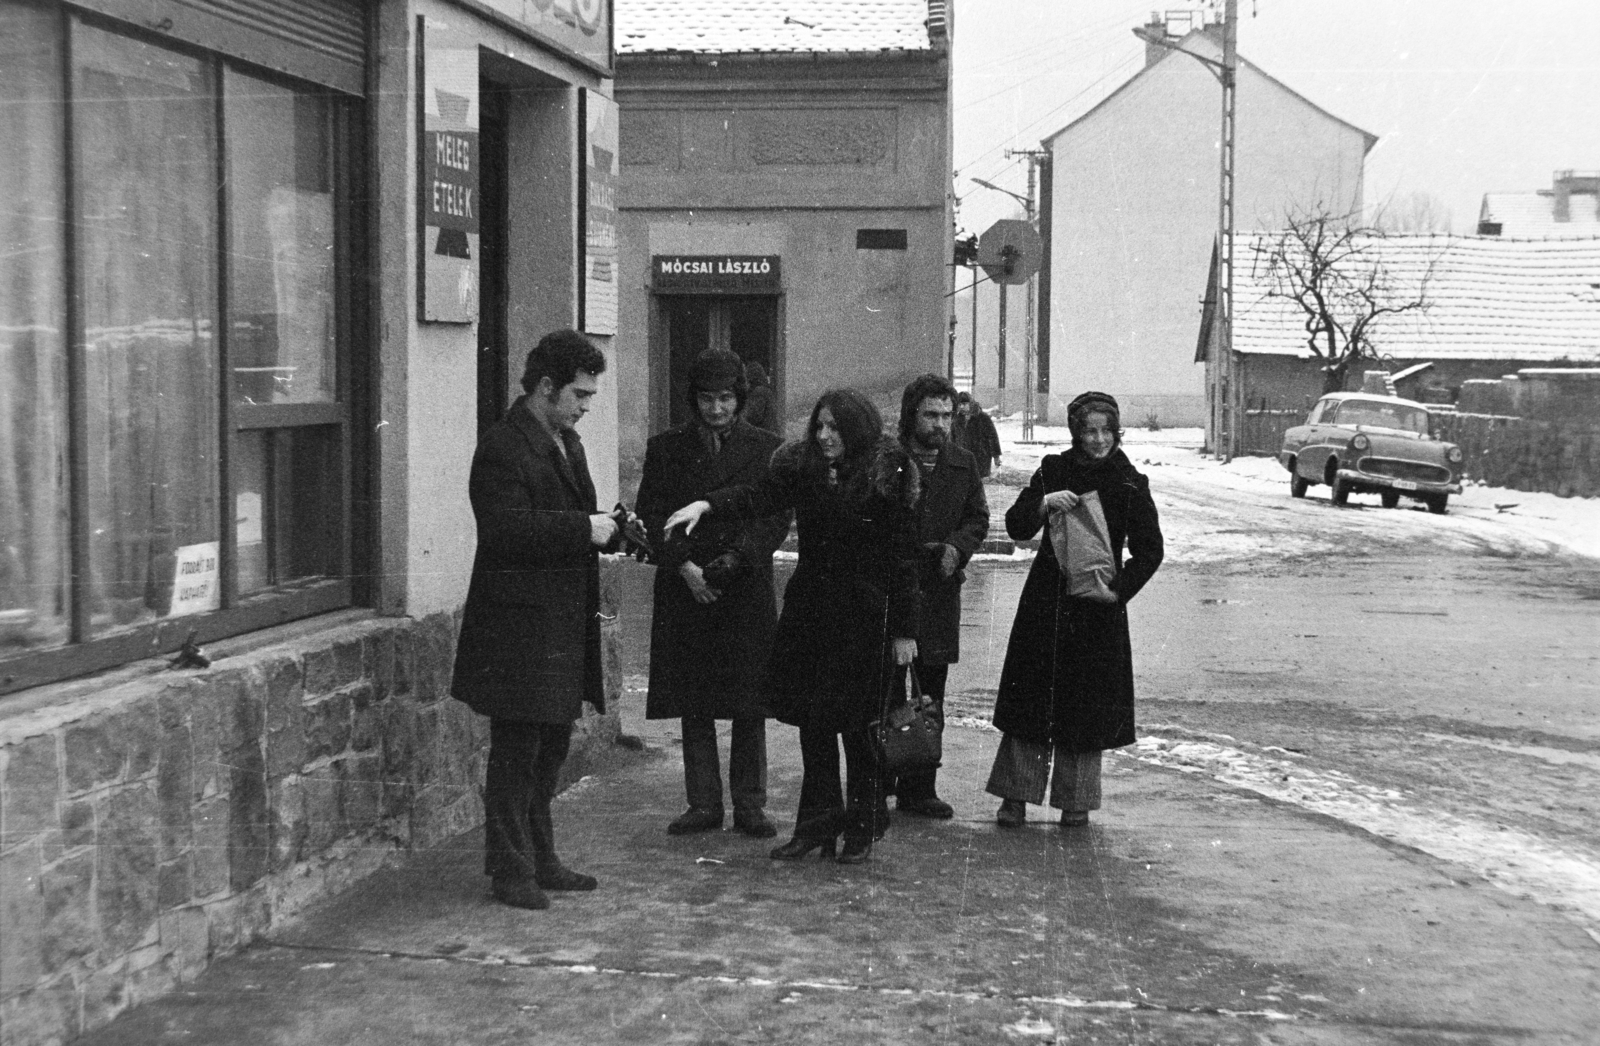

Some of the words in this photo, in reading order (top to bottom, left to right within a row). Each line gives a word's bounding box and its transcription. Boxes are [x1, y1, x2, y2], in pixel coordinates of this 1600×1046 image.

[436, 132, 469, 171] MELEG
[433, 167, 473, 219] ÉTELEK
[661, 258, 713, 274] MÓCSAI
[718, 258, 771, 274] LÁSZLÓ
